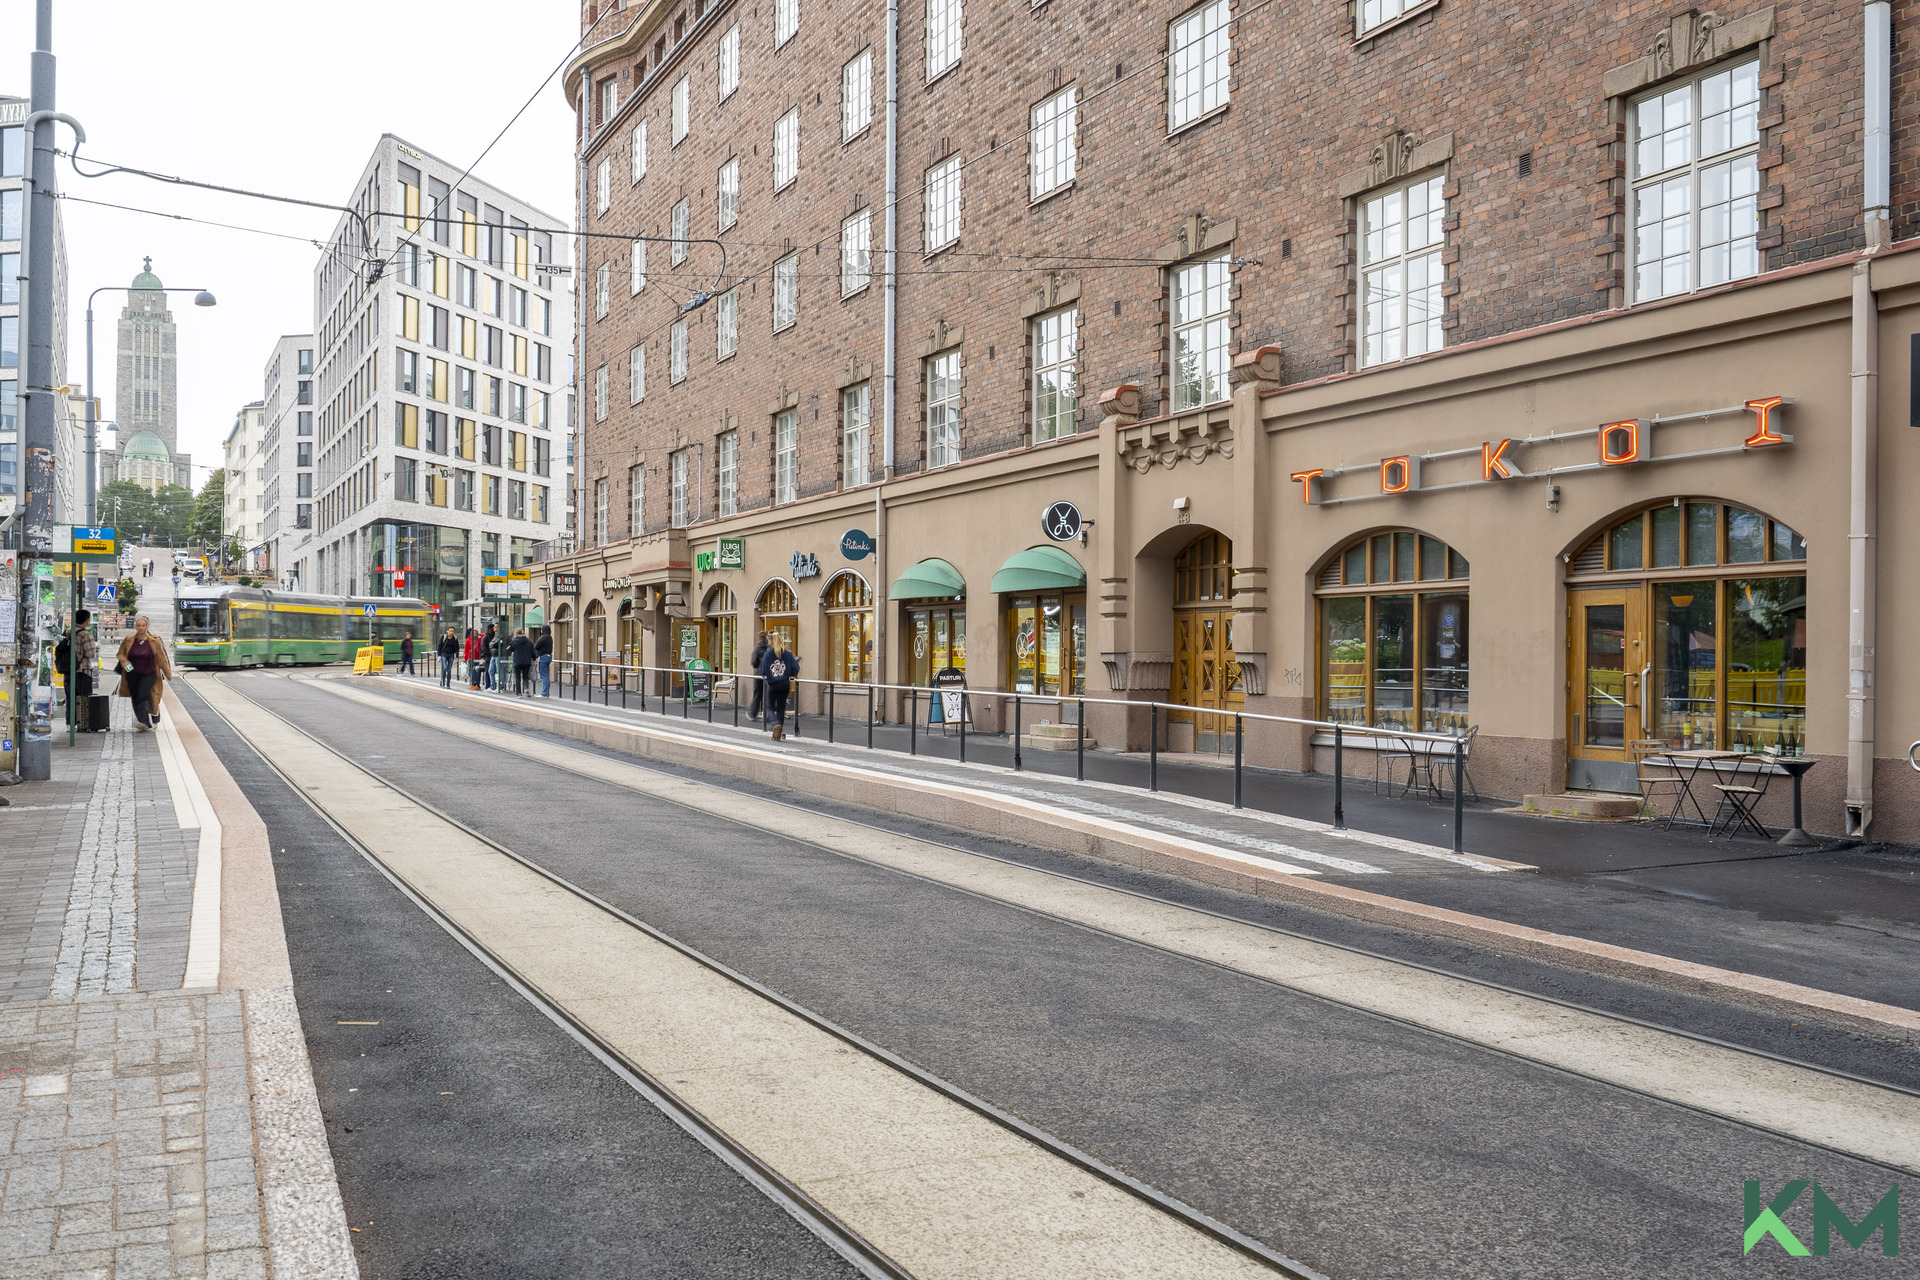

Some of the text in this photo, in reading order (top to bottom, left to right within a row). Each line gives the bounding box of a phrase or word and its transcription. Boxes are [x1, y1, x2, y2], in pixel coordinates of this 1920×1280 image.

[0, 103, 26, 122] YYRA
[548, 266, 558, 274] 35
[1290, 396, 1786, 505] TOKOI
[88, 529, 101, 538] 32
[843, 538, 870, 550] Putinki
[697, 552, 715, 571] LUIGI
